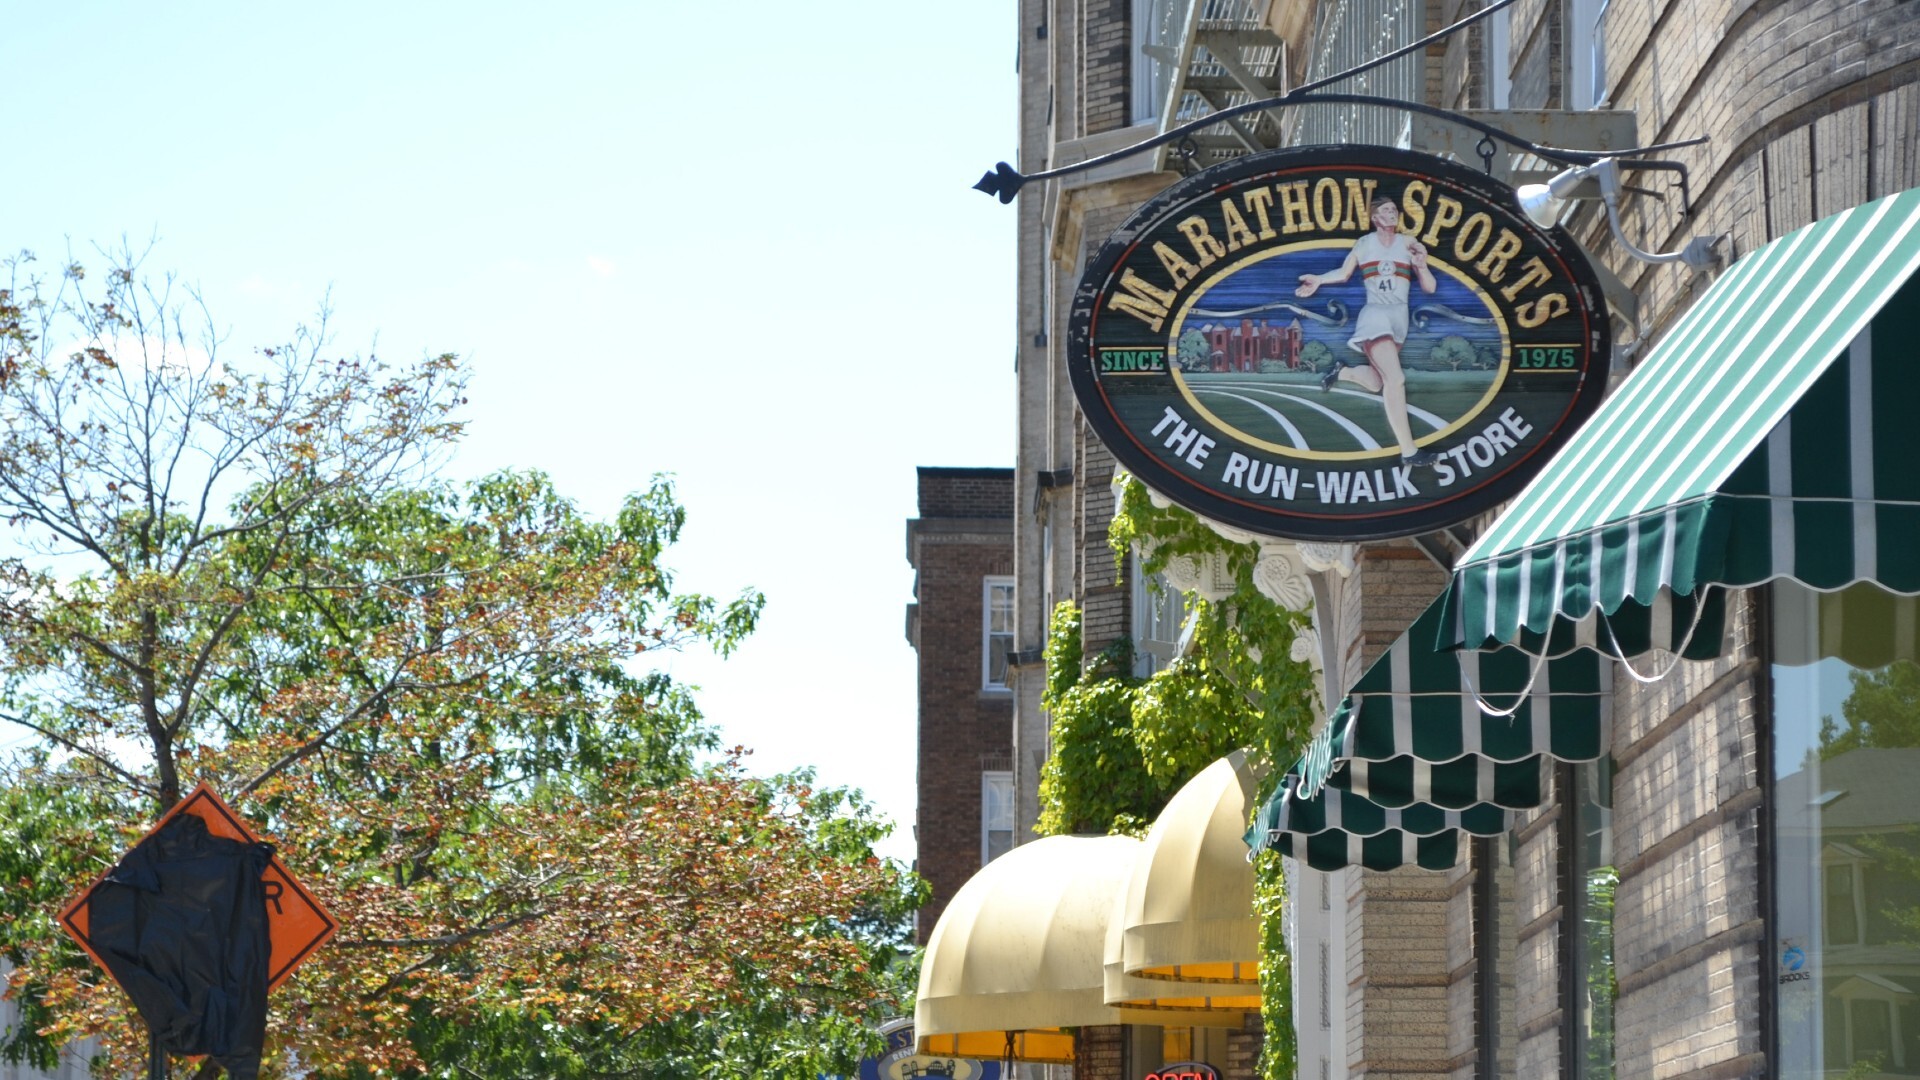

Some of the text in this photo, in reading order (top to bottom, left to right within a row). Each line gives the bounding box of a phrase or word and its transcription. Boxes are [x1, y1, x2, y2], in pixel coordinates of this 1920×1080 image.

[1107, 177, 1570, 333] MARATHON SPORTS
[1379, 278, 1392, 292] 41
[1101, 350, 1164, 371] SINCE
[1519, 349, 1575, 368] 1975
[1150, 405, 1533, 504] THE RUN-WALK STORE
[1779, 971, 1810, 985] BROOKS
